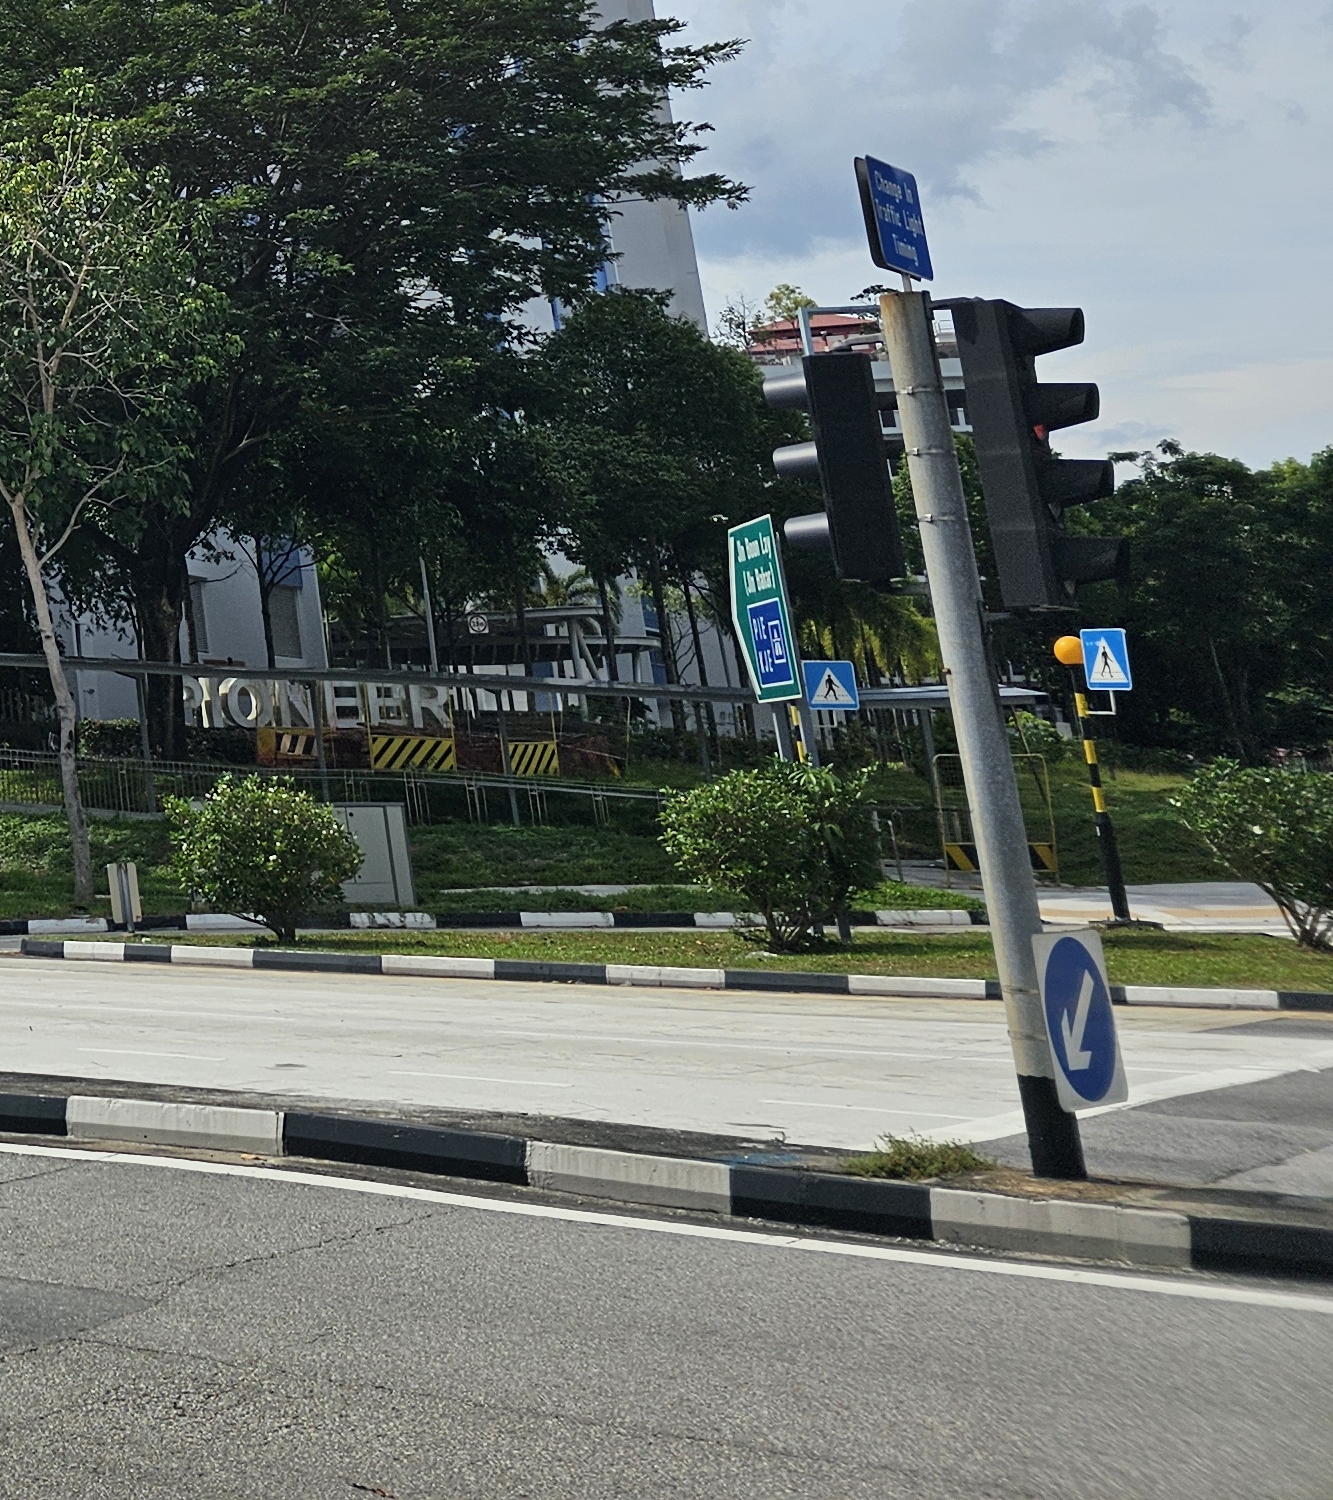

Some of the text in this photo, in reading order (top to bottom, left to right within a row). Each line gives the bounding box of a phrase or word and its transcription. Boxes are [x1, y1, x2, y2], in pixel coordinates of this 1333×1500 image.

[874, 170, 903, 203] Change
[874, 198, 924, 238] Traffic Light
[892, 233, 919, 267] Timing
[744, 537, 761, 560] Boon
[758, 532, 772, 560] Lay
[752, 616, 768, 641] PIE
[758, 649, 774, 674] KJE
[182, 675, 451, 729] PIONEER
